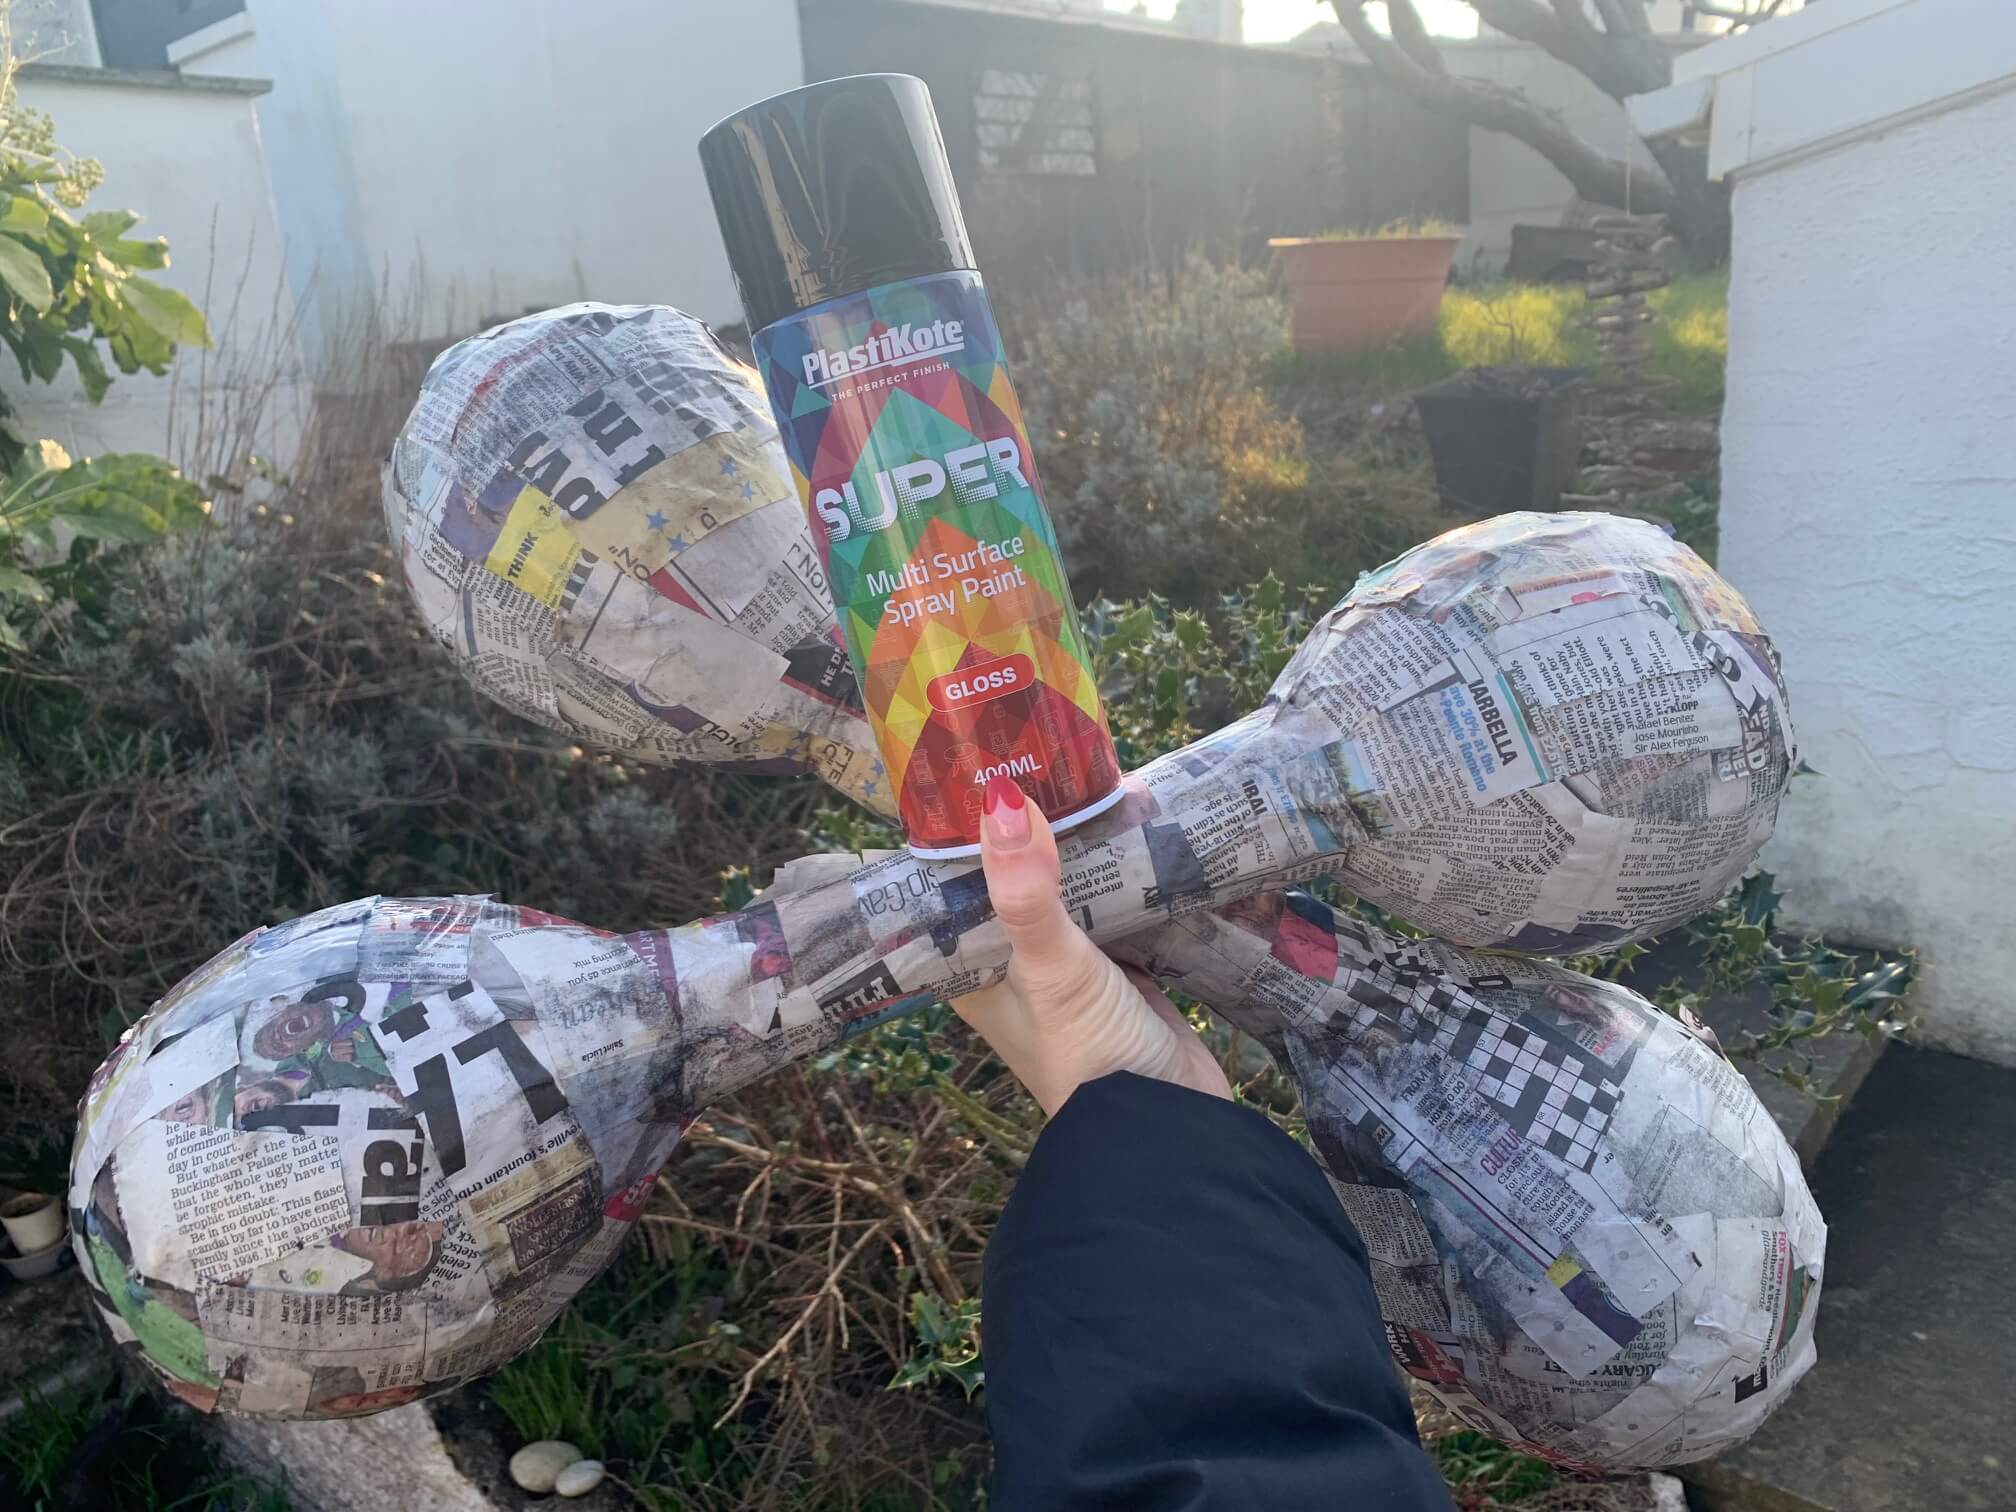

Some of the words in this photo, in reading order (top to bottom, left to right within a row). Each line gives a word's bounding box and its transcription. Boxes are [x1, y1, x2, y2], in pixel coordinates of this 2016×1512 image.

[802, 319, 964, 385] PlastiKote
[831, 388, 854, 402] THE
[856, 372, 909, 395] PERFECT
[912, 361, 951, 378] FINISH
[815, 437, 1029, 544] SUPER
[508, 532, 539, 579] THINK
[866, 559, 930, 597] Multi
[932, 536, 1026, 580] Surface
[764, 600, 780, 617] but
[883, 592, 957, 627] Spray
[961, 566, 1027, 606] Paint
[1397, 618, 1416, 639] Love
[1411, 617, 1449, 659] Goldfinger
[1562, 639, 1576, 658] but
[1594, 633, 1614, 662] were
[1618, 635, 1634, 656] fact
[1647, 628, 1667, 660] touch
[1371, 659, 1388, 677] who
[1545, 654, 1560, 672] for
[1555, 647, 1575, 675] Naby
[945, 666, 1018, 702] GLOSS
[1365, 670, 1387, 694] years
[1537, 659, 1558, 692] thinks
[1555, 670, 1575, 698] gone
[1598, 664, 1614, 687] was
[1360, 680, 1380, 702] 2020
[1603, 691, 1618, 712] her
[1561, 705, 1586, 748] putting
[1586, 709, 1601, 730] she
[1662, 712, 1695, 726] Benitez
[1459, 707, 1482, 737] 30%
[1478, 751, 1499, 775] the
[1593, 730, 1610, 754] says
[1633, 731, 1655, 742] Jose
[1656, 723, 1698, 738] Mourinho
[1634, 742, 1648, 753] Sir
[1649, 739, 1671, 750] Alex
[1672, 734, 1709, 749] Ferguson
[1416, 723, 1442, 761] Romano
[1432, 760, 1452, 786] Beach
[1436, 697, 1469, 742] Puente
[1455, 741, 1492, 793] Romano
[1416, 753, 1440, 786] Golden
[1431, 726, 1458, 768] relaxation
[1450, 768, 1467, 789] head
[1368, 735, 1383, 752] you
[1396, 797, 1413, 819] ready
[1392, 758, 1413, 788] Senses
[1404, 787, 1419, 803] Spa
[1192, 815, 1215, 832] Edin
[1223, 814, 1241, 828] the
[1240, 808, 1252, 820] of
[1452, 816, 1477, 826] then
[1503, 816, 1542, 829] Sydney
[1199, 823, 1223, 840] men
[1409, 828, 1485, 845] powerbrokers
[1489, 834, 1518, 845] great
[1509, 826, 1541, 837] music
[1541, 827, 1557, 843] the
[1553, 824, 1565, 835] in
[1420, 838, 1454, 850] career
[1452, 849, 1505, 862] Australian
[1465, 843, 1490, 853] built
[1493, 844, 1513, 853] had
[1516, 844, 1539, 853] man
[1624, 852, 1647, 862] Reid
[1651, 852, 1675, 861] John
[1069, 878, 1093, 895] goal
[1074, 871, 1086, 880] to
[1093, 877, 1100, 885] a
[1478, 872, 1534, 888] explained
[1616, 894, 1633, 902] the
[566, 972, 587, 987] you
[586, 970, 599, 979] as
[580, 1048, 603, 1063] Lucia
[601, 1038, 624, 1053] Saint
[1399, 1069, 1429, 1103] FROM
[165, 1128, 197, 1147] while
[165, 1148, 179, 1162] of
[178, 1131, 231, 1157] common
[166, 1158, 191, 1175] day
[190, 1153, 204, 1166] in
[204, 1141, 241, 1161] court.
[168, 1166, 244, 1199] Buckingham
[247, 1151, 289, 1172] Palace
[291, 1140, 317, 1157] had
[175, 1168, 198, 1184] But
[200, 1147, 260, 1175] whatever
[263, 1138, 287, 1153] the
[482, 1149, 538, 1187] fountain
[1496, 1151, 1525, 1186] CLOSE
[171, 1193, 197, 1211] that
[199, 1185, 220, 1200] the
[221, 1172, 262, 1193] whole
[264, 1160, 294, 1180] ugly
[192, 1188, 256, 1218] forgotten,
[258, 1176, 289, 1195] they
[292, 1163, 325, 1181] have
[1512, 1160, 1547, 1201] precious
[1528, 1185, 1554, 1215] cough
[1542, 1180, 1571, 1215] Mooted
[175, 1210, 226, 1236] strophic
[226, 1192, 280, 1218] mistake.
[189, 1231, 205, 1243] Be
[206, 1226, 218, 1237] in
[281, 1194, 311, 1212] This
[1545, 1200, 1569, 1228] island
[1564, 1193, 1575, 1204] is
[1552, 1205, 1576, 1234] house
[186, 1235, 230, 1258] scandal
[246, 1223, 264, 1237] far
[280, 1206, 312, 1226] have
[1776, 1231, 1786, 1254] FOX
[189, 1247, 230, 1270] Family
[230, 1236, 265, 1256] since
[1775, 1257, 1783, 1284] TROT
[1381, 1318, 1410, 1365] WORK
